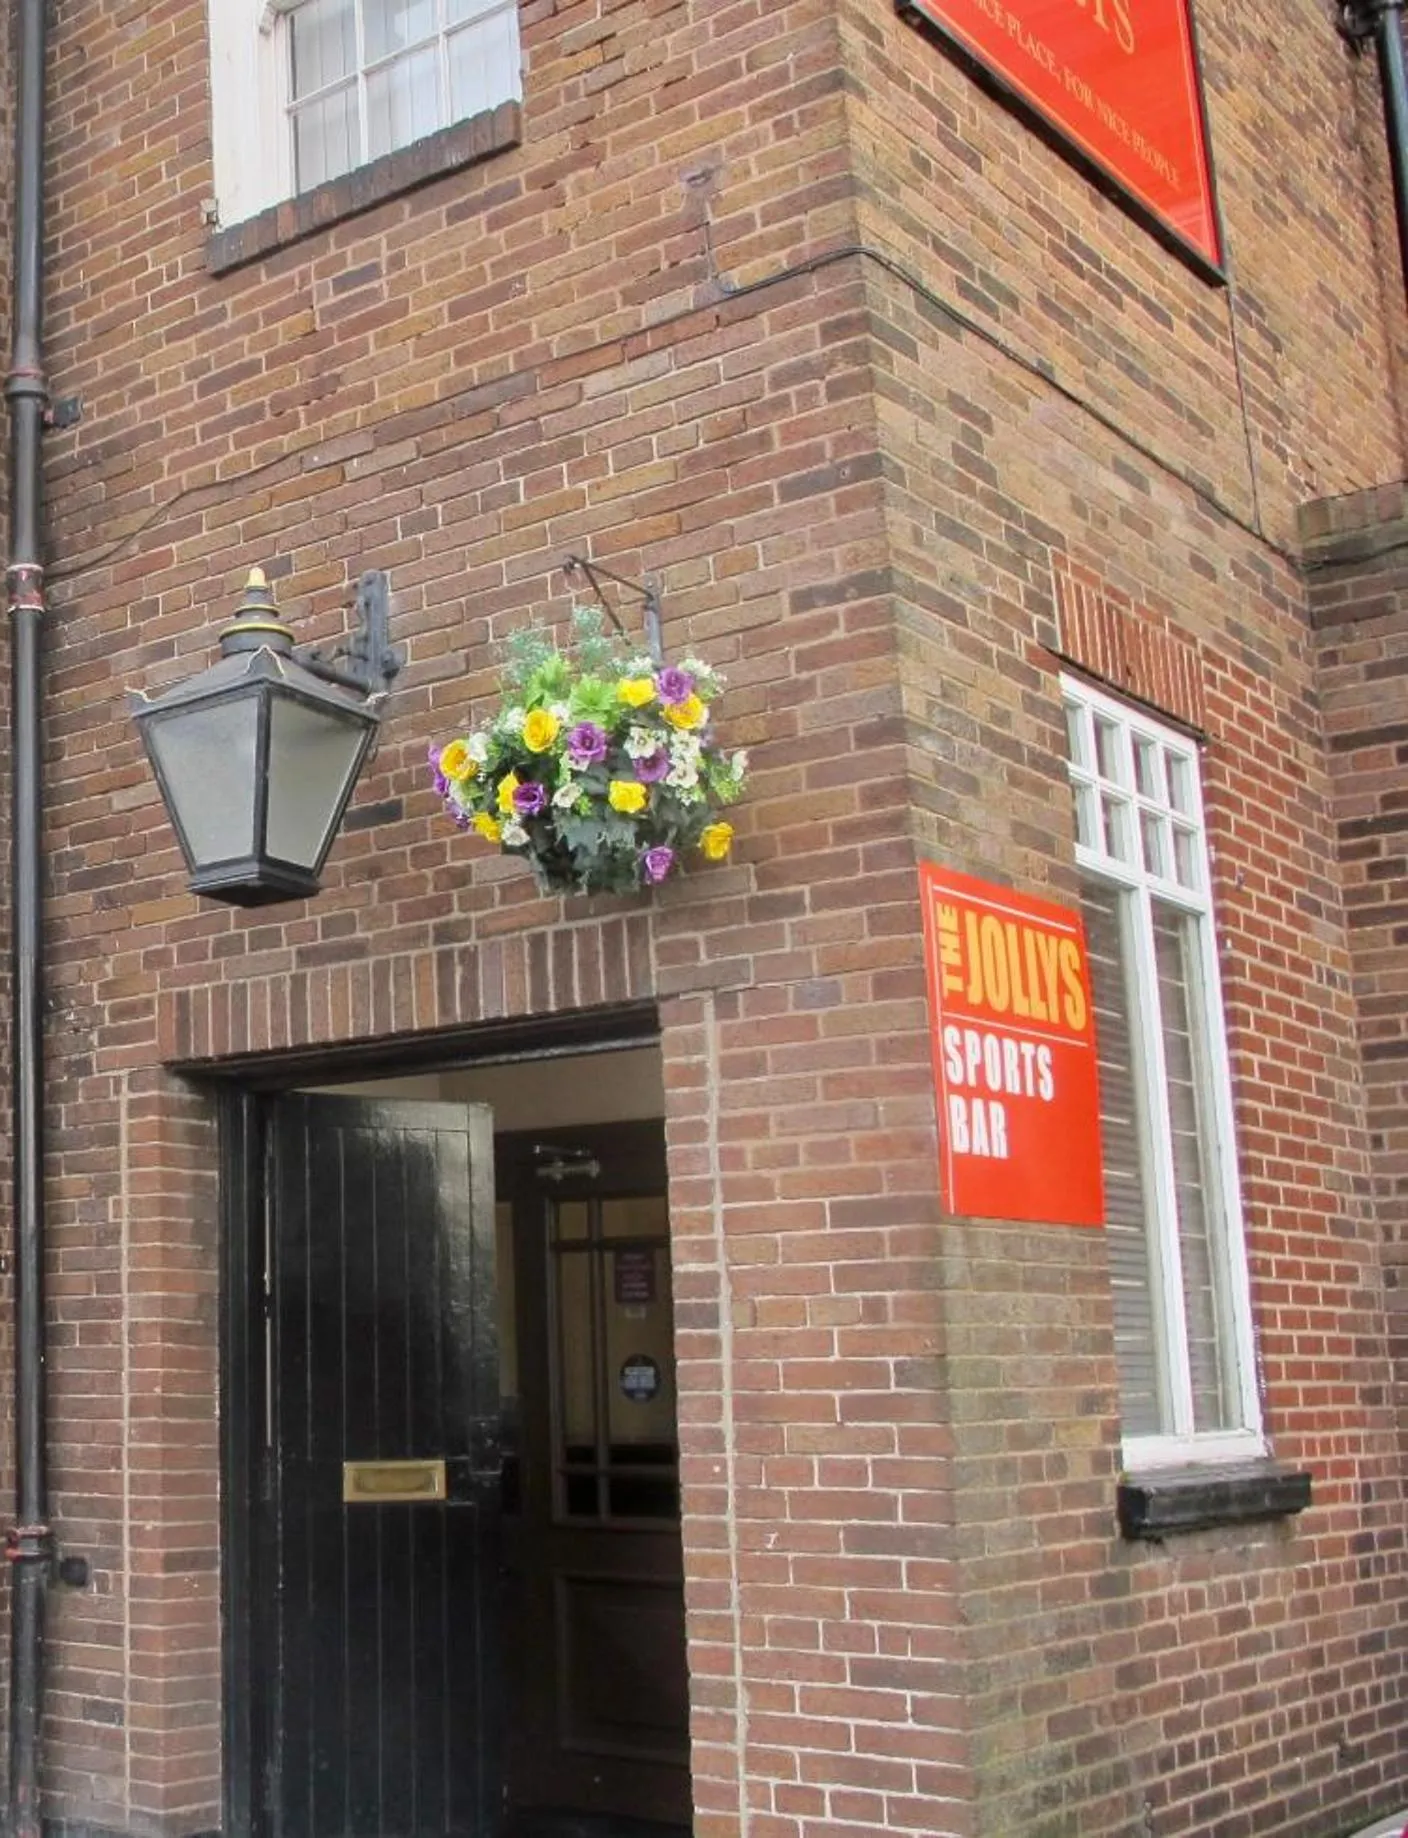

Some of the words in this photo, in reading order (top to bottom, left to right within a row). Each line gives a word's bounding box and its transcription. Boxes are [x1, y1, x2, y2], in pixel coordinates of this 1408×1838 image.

[936, 900, 964, 998] THE
[964, 909, 1087, 1031] JOLLYS
[943, 1024, 1055, 1102] SPORTS
[949, 1093, 1009, 1160] BAR
